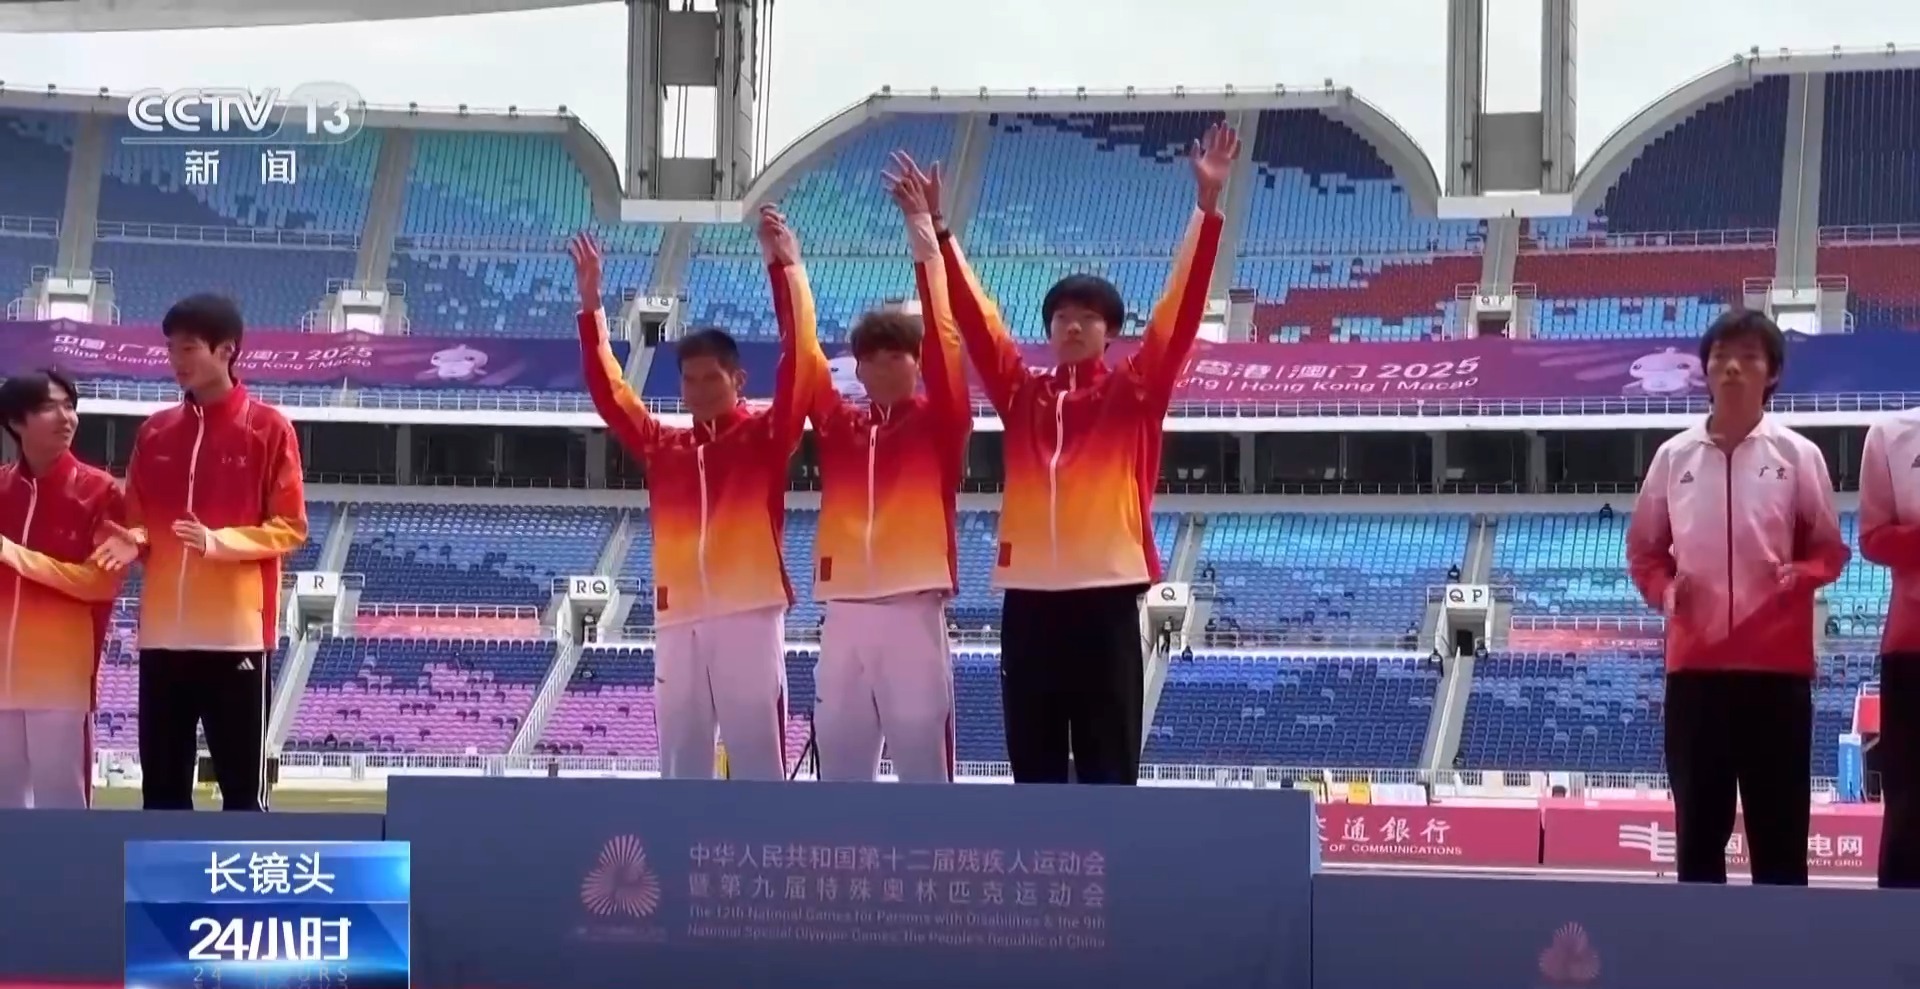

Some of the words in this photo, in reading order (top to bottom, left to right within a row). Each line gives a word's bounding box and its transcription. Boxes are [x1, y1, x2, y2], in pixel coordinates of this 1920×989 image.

[305, 345, 374, 361] 2025
[262, 361, 304, 371] Kong
[318, 357, 372, 369] Macao
[1377, 356, 1480, 379] 2025
[1241, 380, 1305, 393] Hong
[1312, 381, 1375, 393] Kong
[1398, 376, 1479, 391] Macao
[314, 575, 324, 589] R
[1161, 586, 1177, 601] Q
[1330, 844, 1346, 853] OF
[1352, 844, 1463, 856] COMMUNICATIONS
[690, 842, 1105, 876] 中华人民共和国第十二届残疾人运动会
[1834, 859, 1863, 868] GRID
